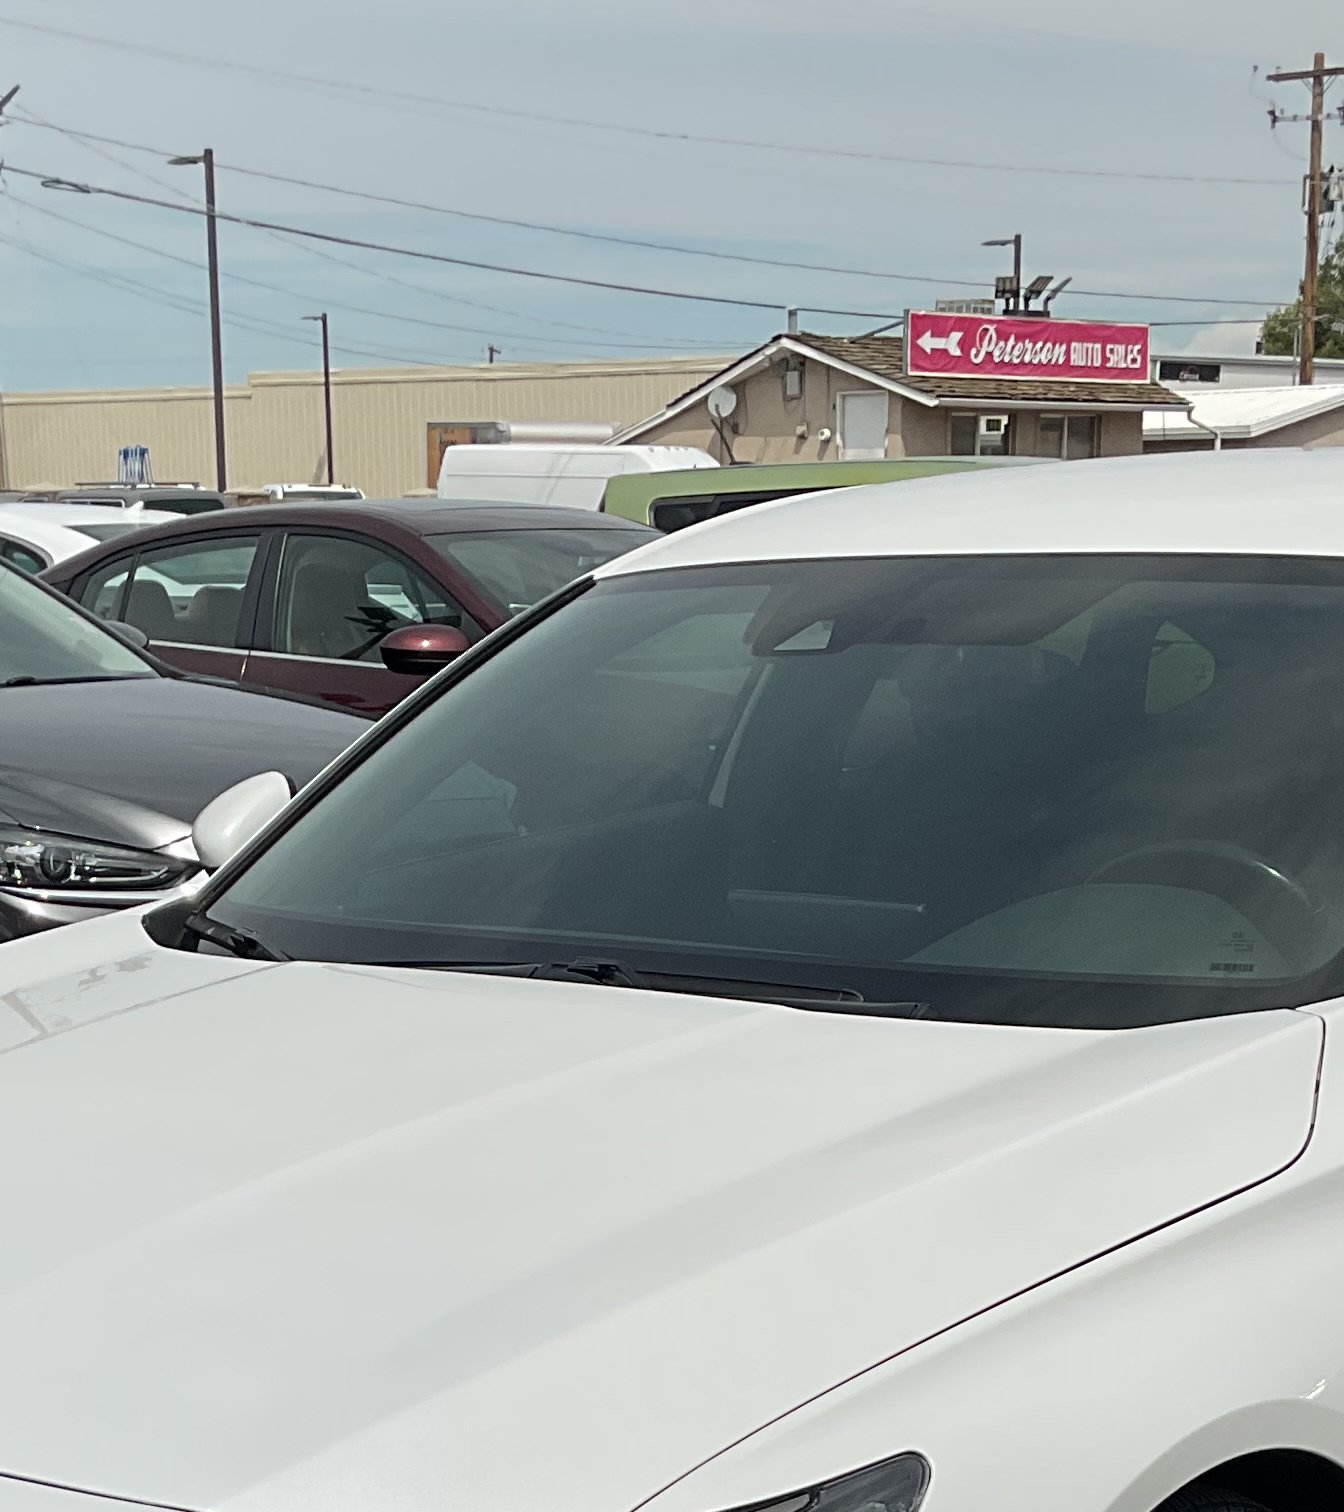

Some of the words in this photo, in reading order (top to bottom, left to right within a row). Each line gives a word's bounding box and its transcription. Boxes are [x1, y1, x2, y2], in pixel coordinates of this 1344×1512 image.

[970, 324, 1067, 366] Peterson
[1070, 341, 1102, 368] AUTO
[1106, 343, 1143, 369] SALES
